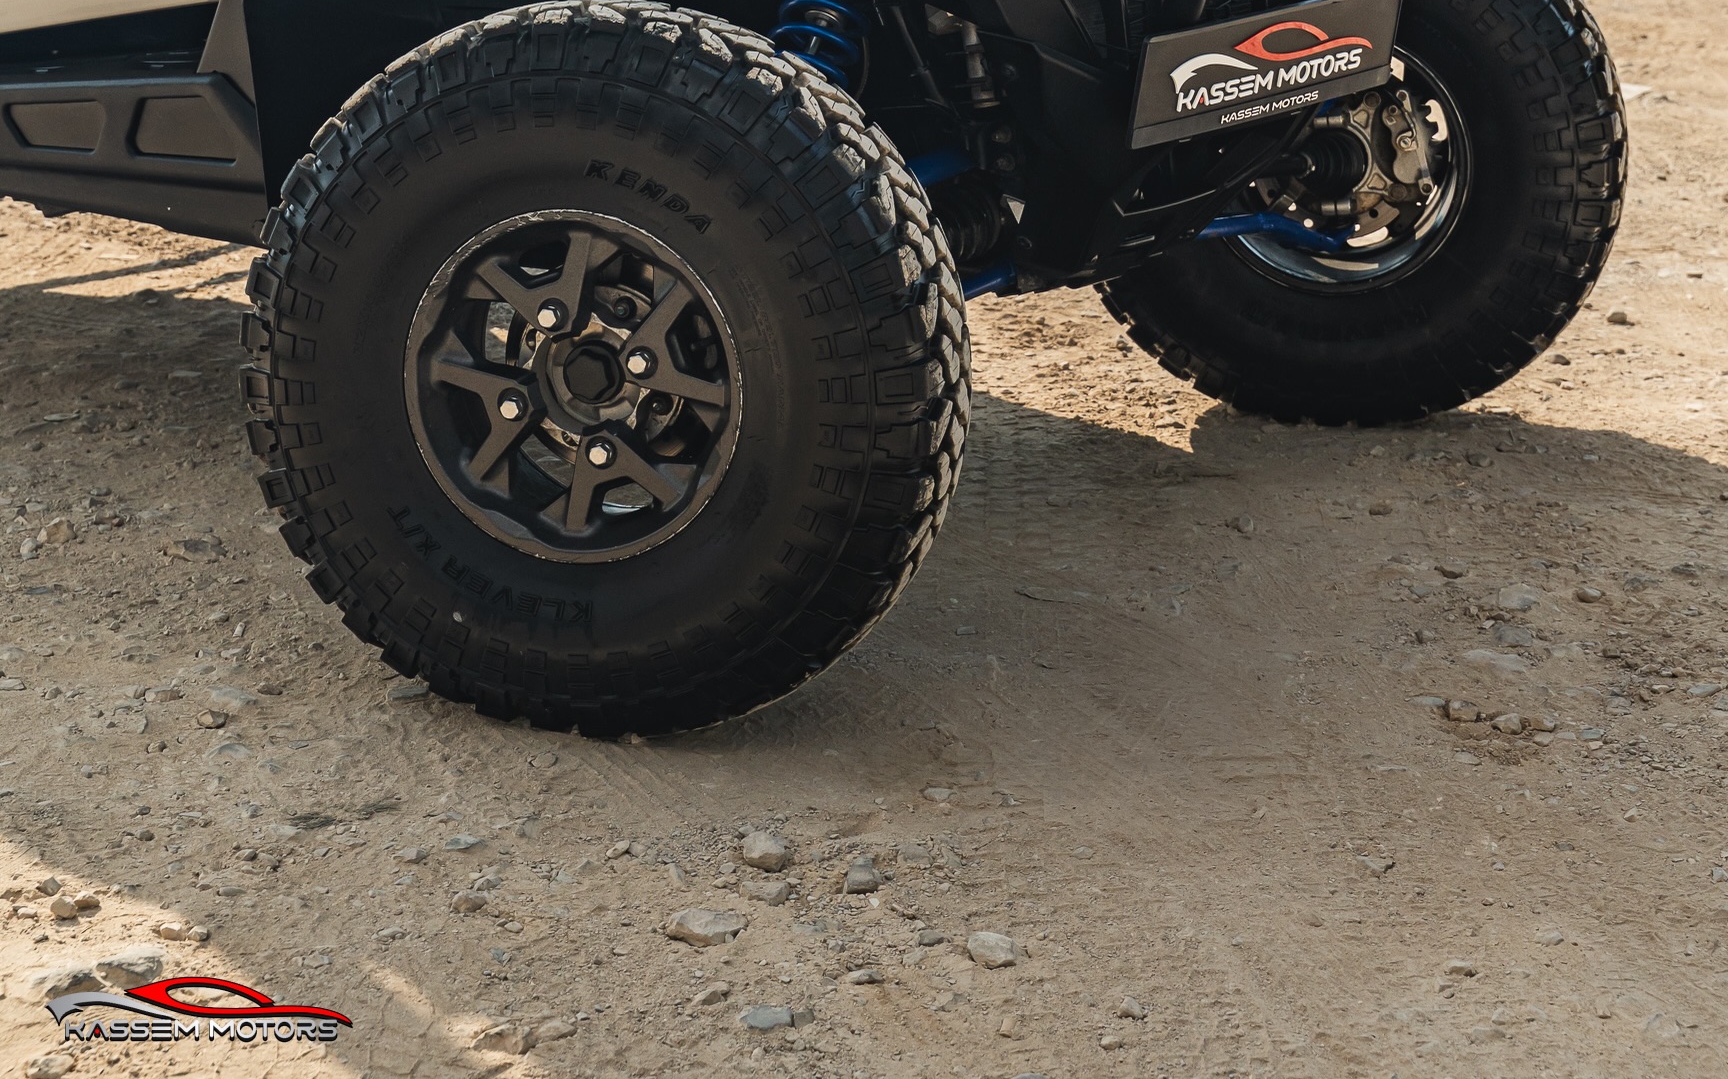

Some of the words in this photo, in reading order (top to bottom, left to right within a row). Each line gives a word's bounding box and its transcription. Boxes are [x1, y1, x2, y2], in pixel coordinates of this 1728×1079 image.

[1175, 70, 1274, 113] KASSEM
[1276, 48, 1363, 88] MOTORS
[1220, 103, 1270, 125] KASSEM
[1271, 90, 1319, 111] MOTORS
[584, 159, 713, 234] KENDA
[441, 556, 594, 622] KLEVER
